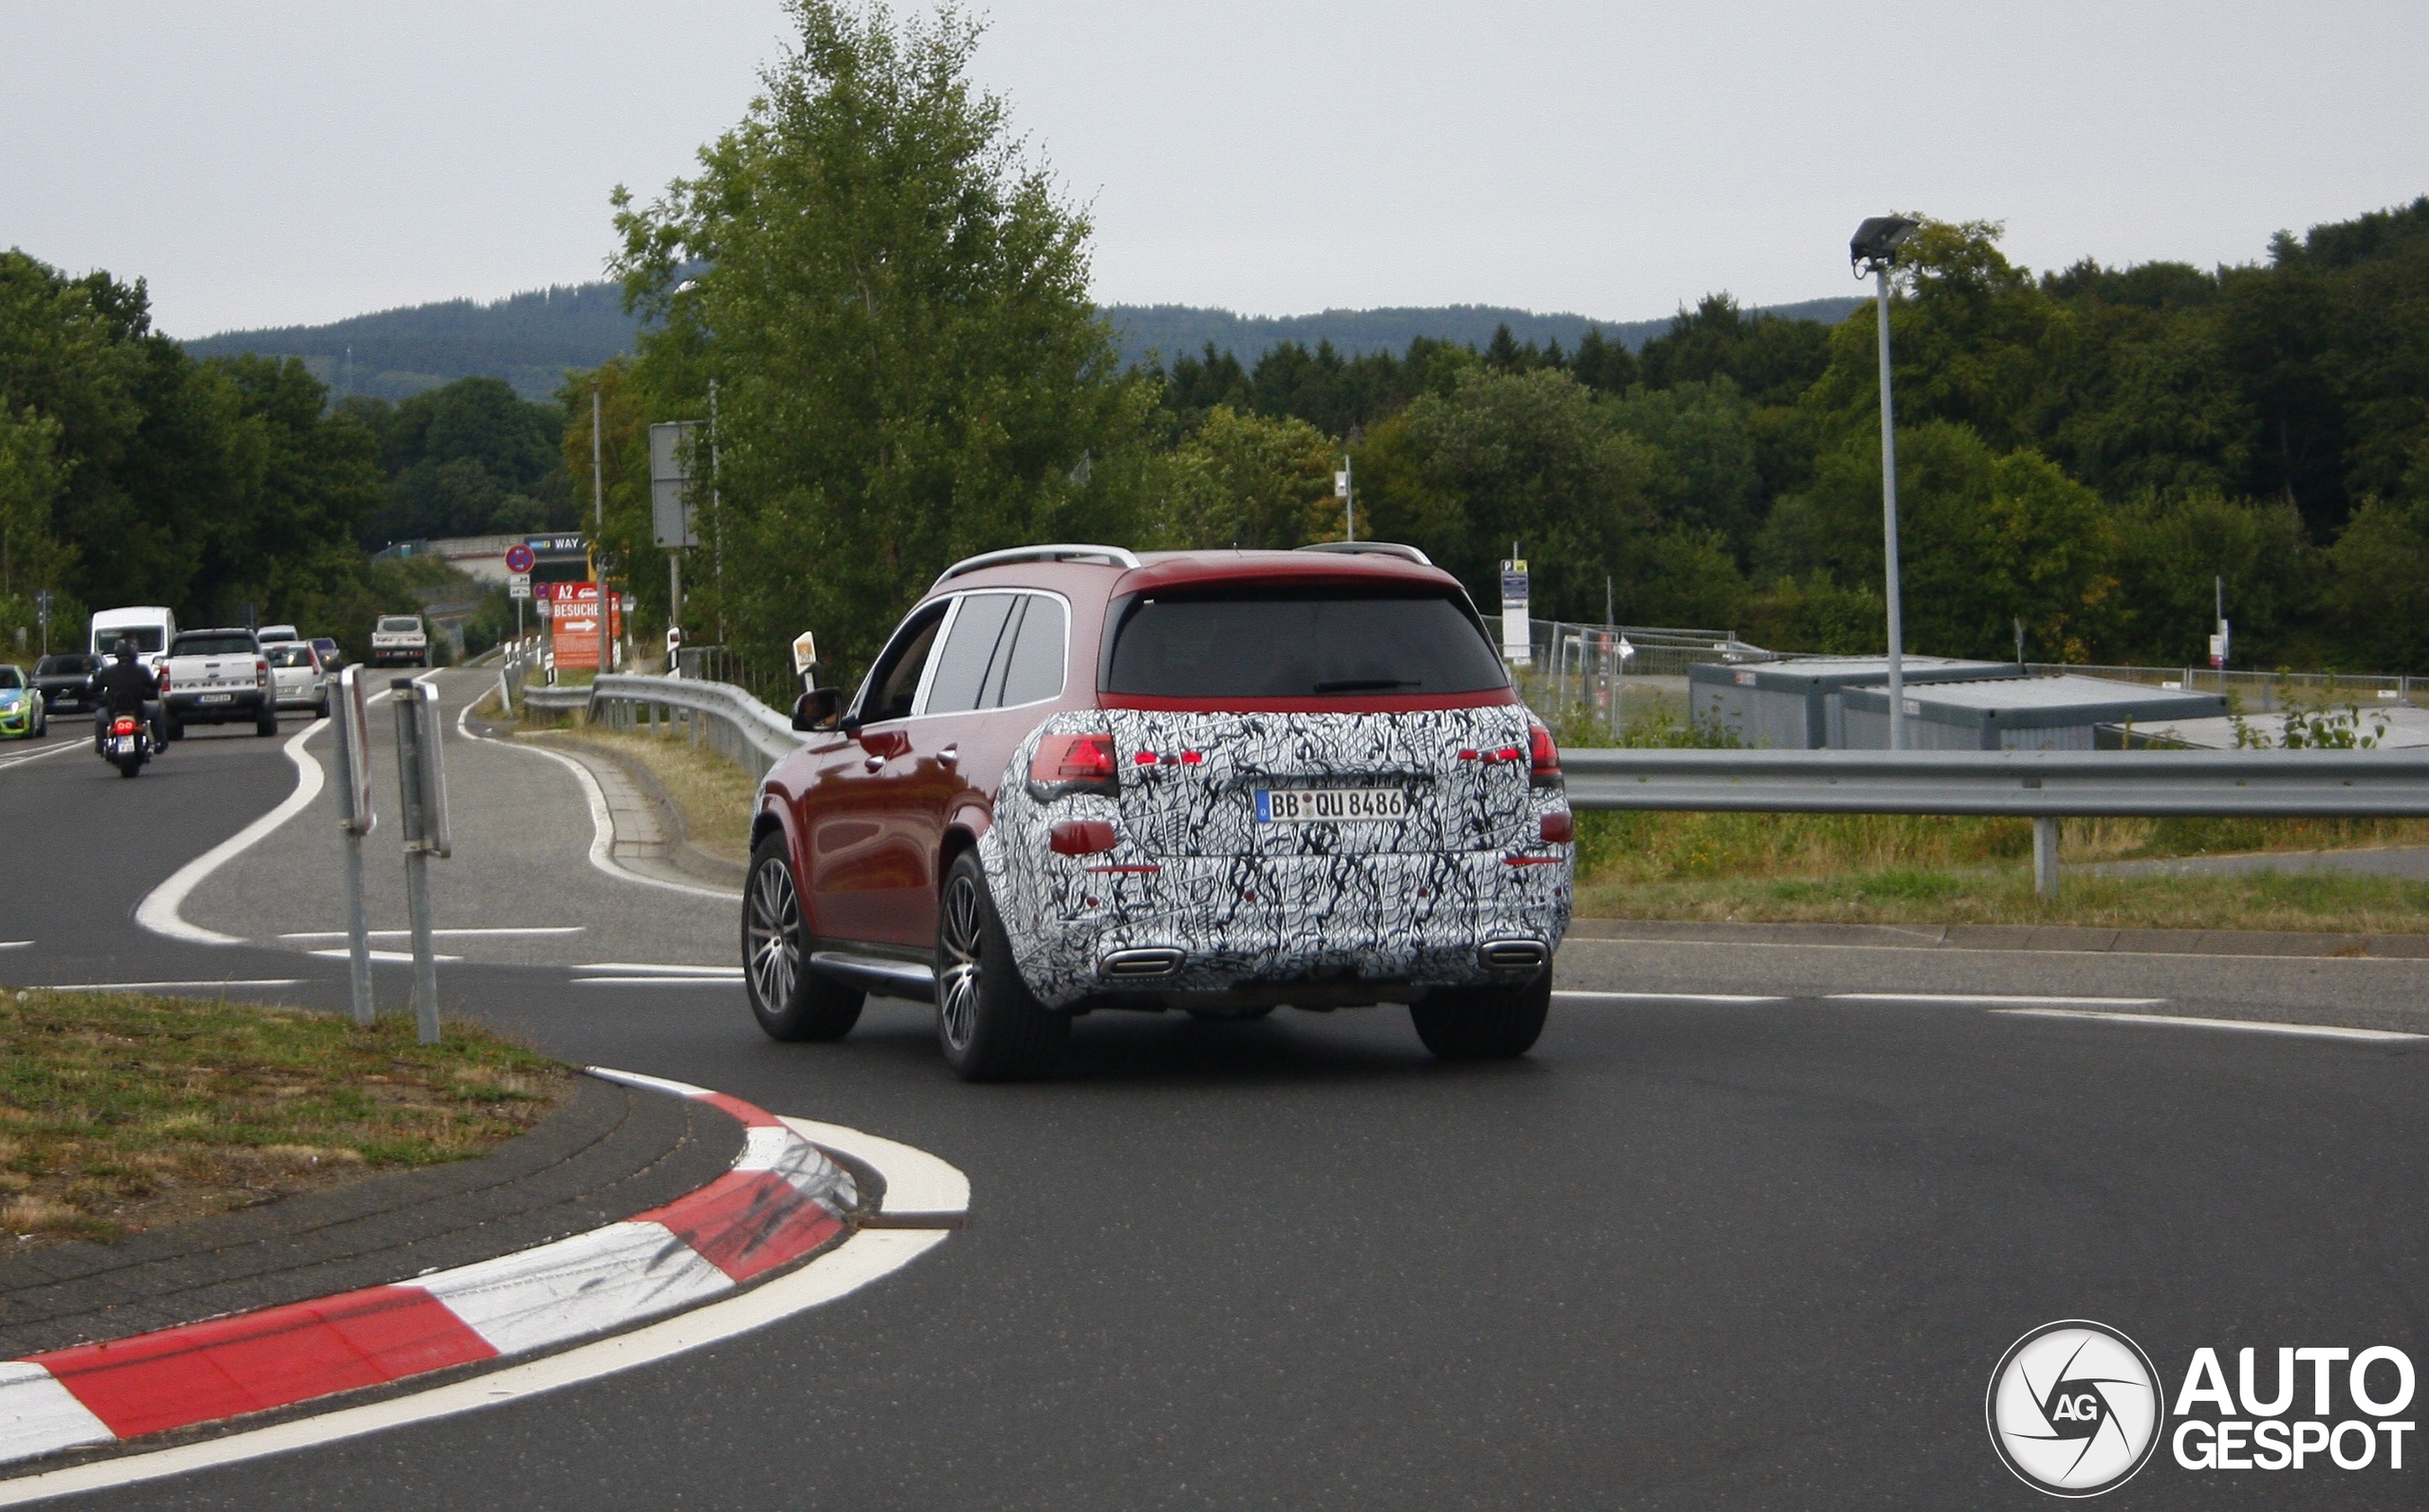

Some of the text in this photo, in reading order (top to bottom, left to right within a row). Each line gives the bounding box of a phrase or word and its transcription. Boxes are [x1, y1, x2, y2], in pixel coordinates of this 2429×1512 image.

[555, 538, 579, 549] WAY
[1505, 561, 1511, 571] P
[558, 584, 573, 599] A2
[554, 602, 599, 617] BESUCHE
[173, 679, 255, 689] RANGER
[1271, 793, 1299, 818] BB
[1316, 792, 1344, 817] QU
[1349, 791, 1401, 816] 8486
